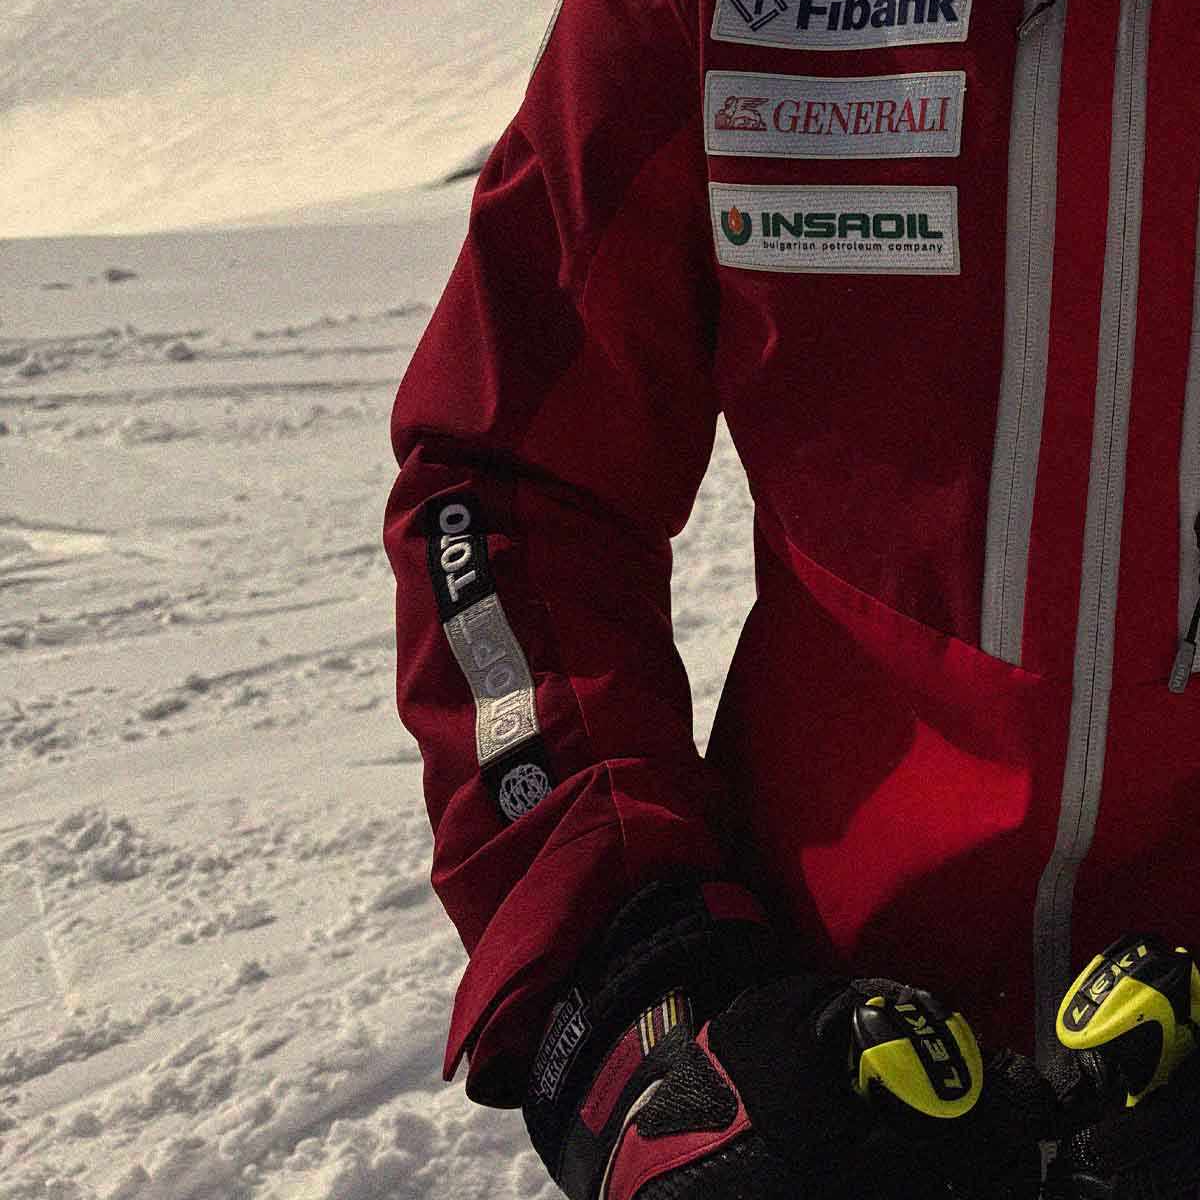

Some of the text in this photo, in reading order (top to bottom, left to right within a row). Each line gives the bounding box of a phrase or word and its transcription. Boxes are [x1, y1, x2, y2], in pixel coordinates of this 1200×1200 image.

[772, 97, 950, 136] GENERALI
[761, 212, 944, 239] INSAOIL
[763, 240, 943, 253] bulgarian petroleum company
[1071, 944, 1148, 1024] LEKI
[895, 1003, 963, 1088] LEKI
